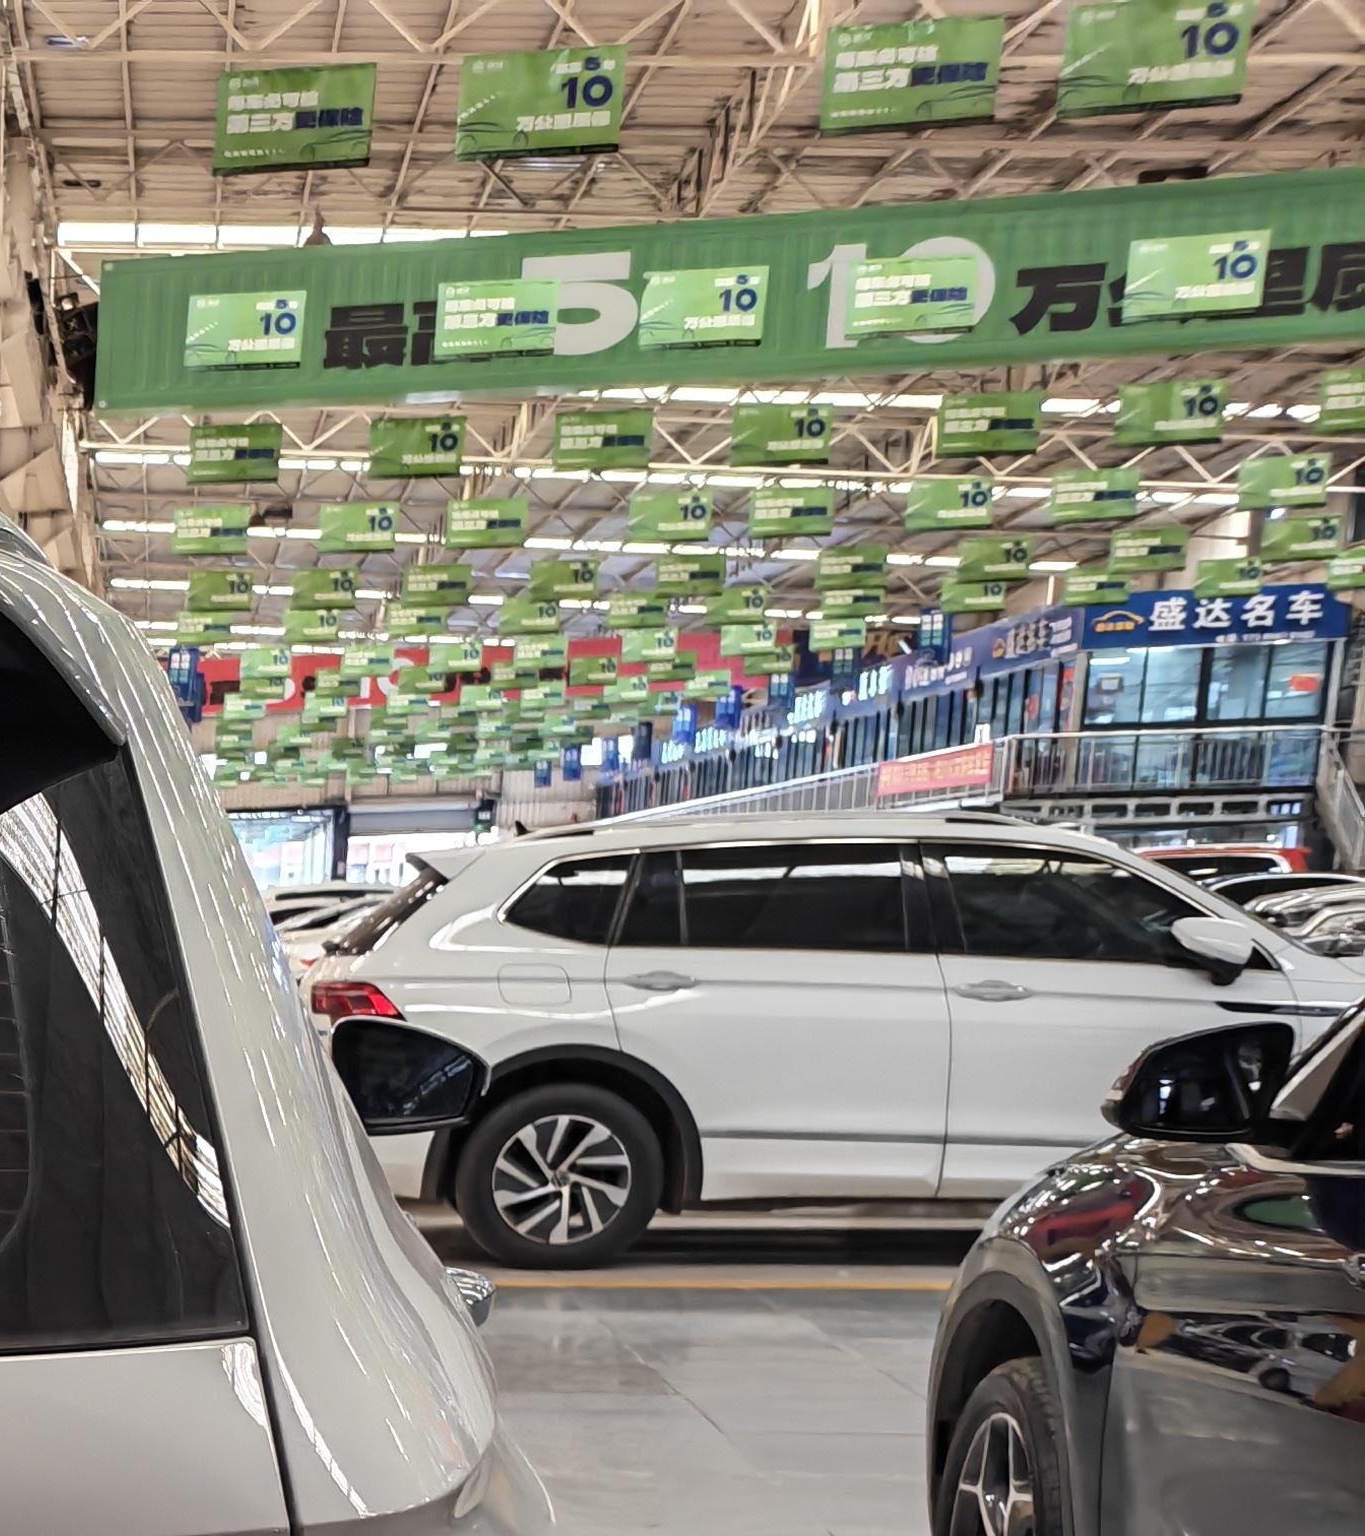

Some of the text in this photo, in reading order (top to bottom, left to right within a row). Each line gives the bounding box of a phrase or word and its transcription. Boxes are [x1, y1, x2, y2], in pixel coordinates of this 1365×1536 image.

[1181, 21, 1239, 59] 10
[561, 75, 613, 108] 10
[1214, 254, 1257, 280] 10
[719, 288, 757, 312] 10
[260, 312, 296, 335] 10
[1183, 396, 1218, 417] 10
[794, 418, 826, 437] 10
[429, 432, 458, 452] 10
[959, 490, 987, 507] 10
[681, 503, 706, 520] 10
[370, 516, 393, 532] 10
[1147, 589, 1325, 632] 盛达名车
